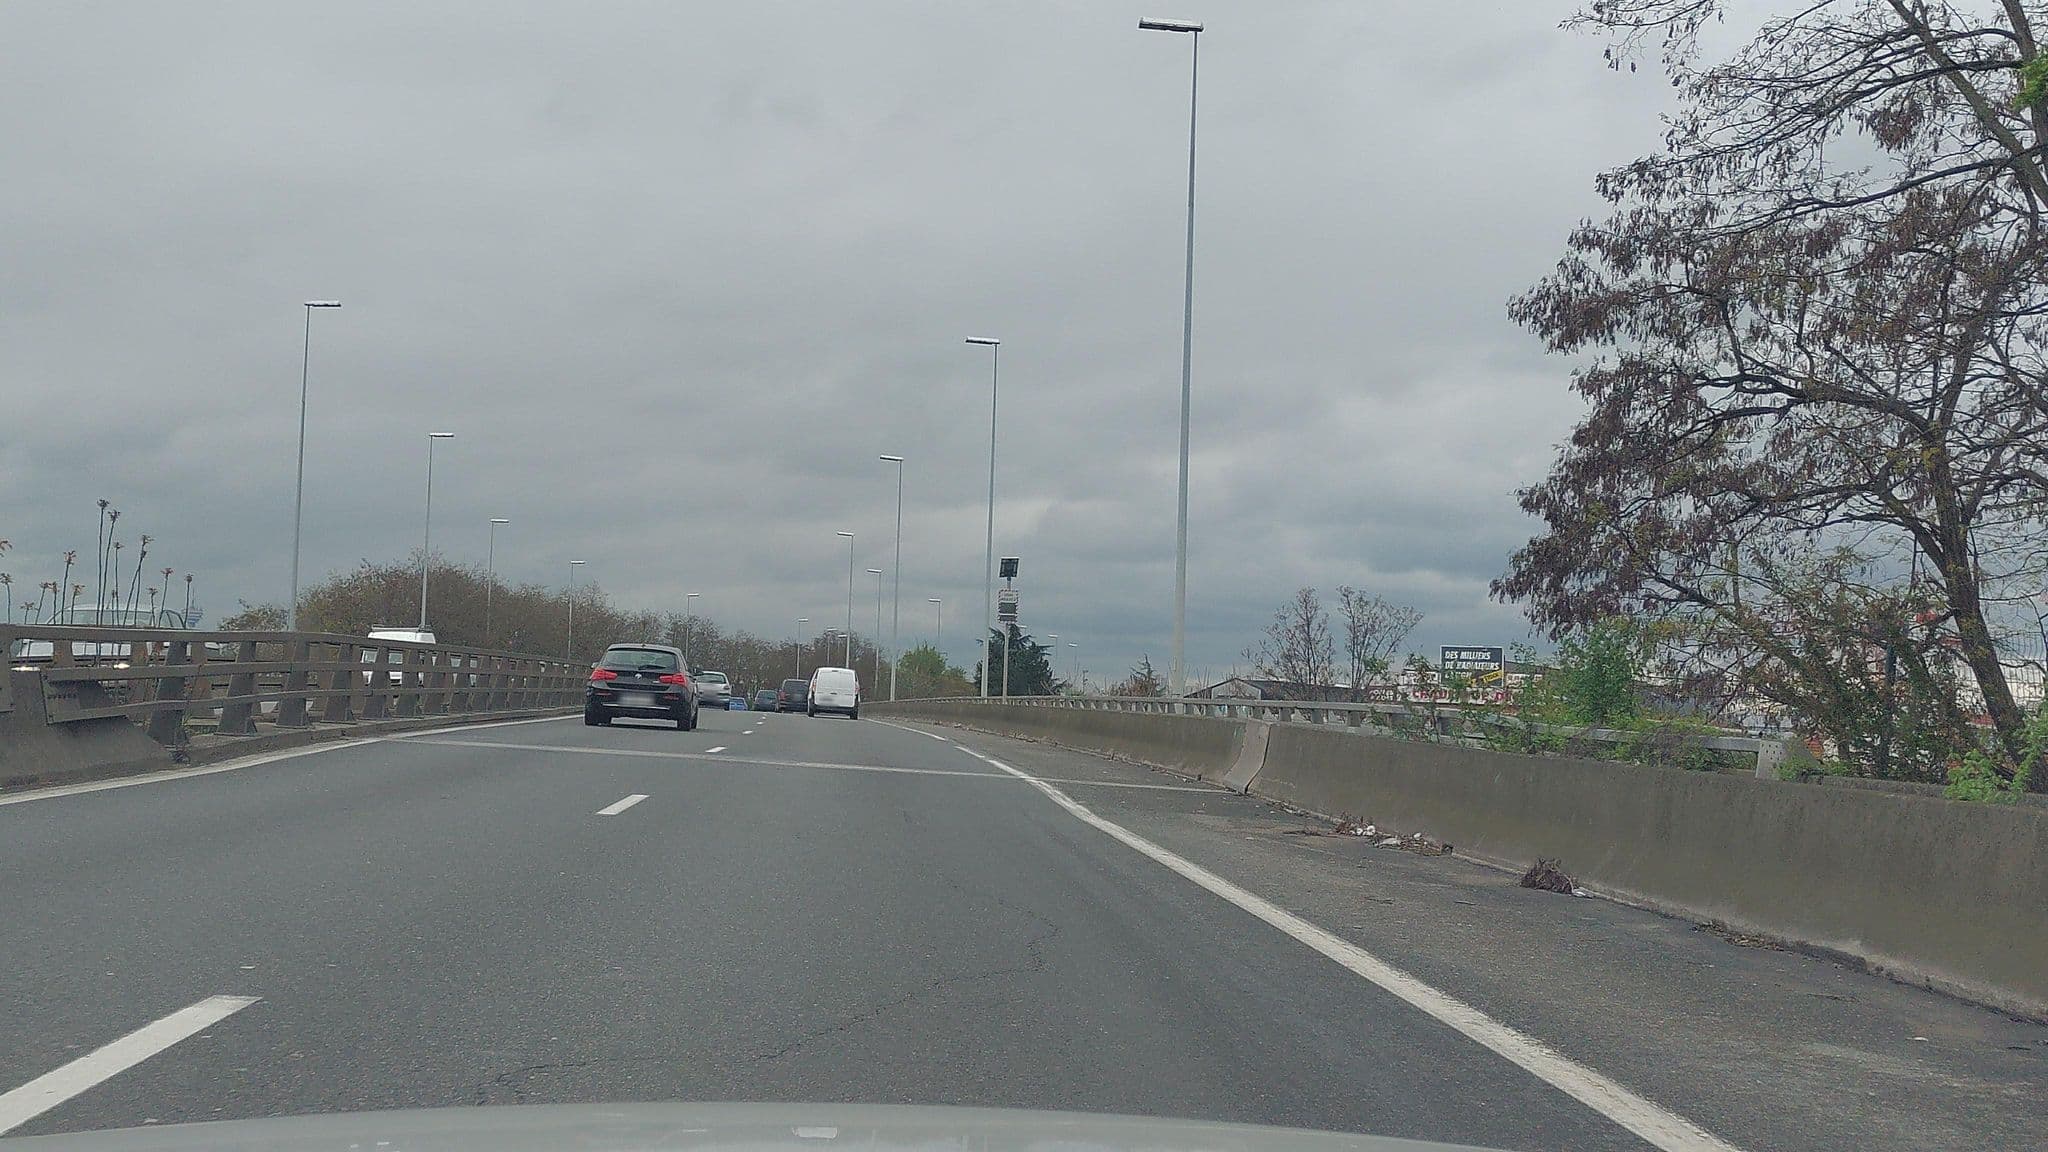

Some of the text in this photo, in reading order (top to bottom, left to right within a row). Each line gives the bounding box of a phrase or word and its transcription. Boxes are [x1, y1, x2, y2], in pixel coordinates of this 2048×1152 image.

[1445, 651, 1491, 660] DES MILLIERS
[1445, 661, 1455, 669] DE
